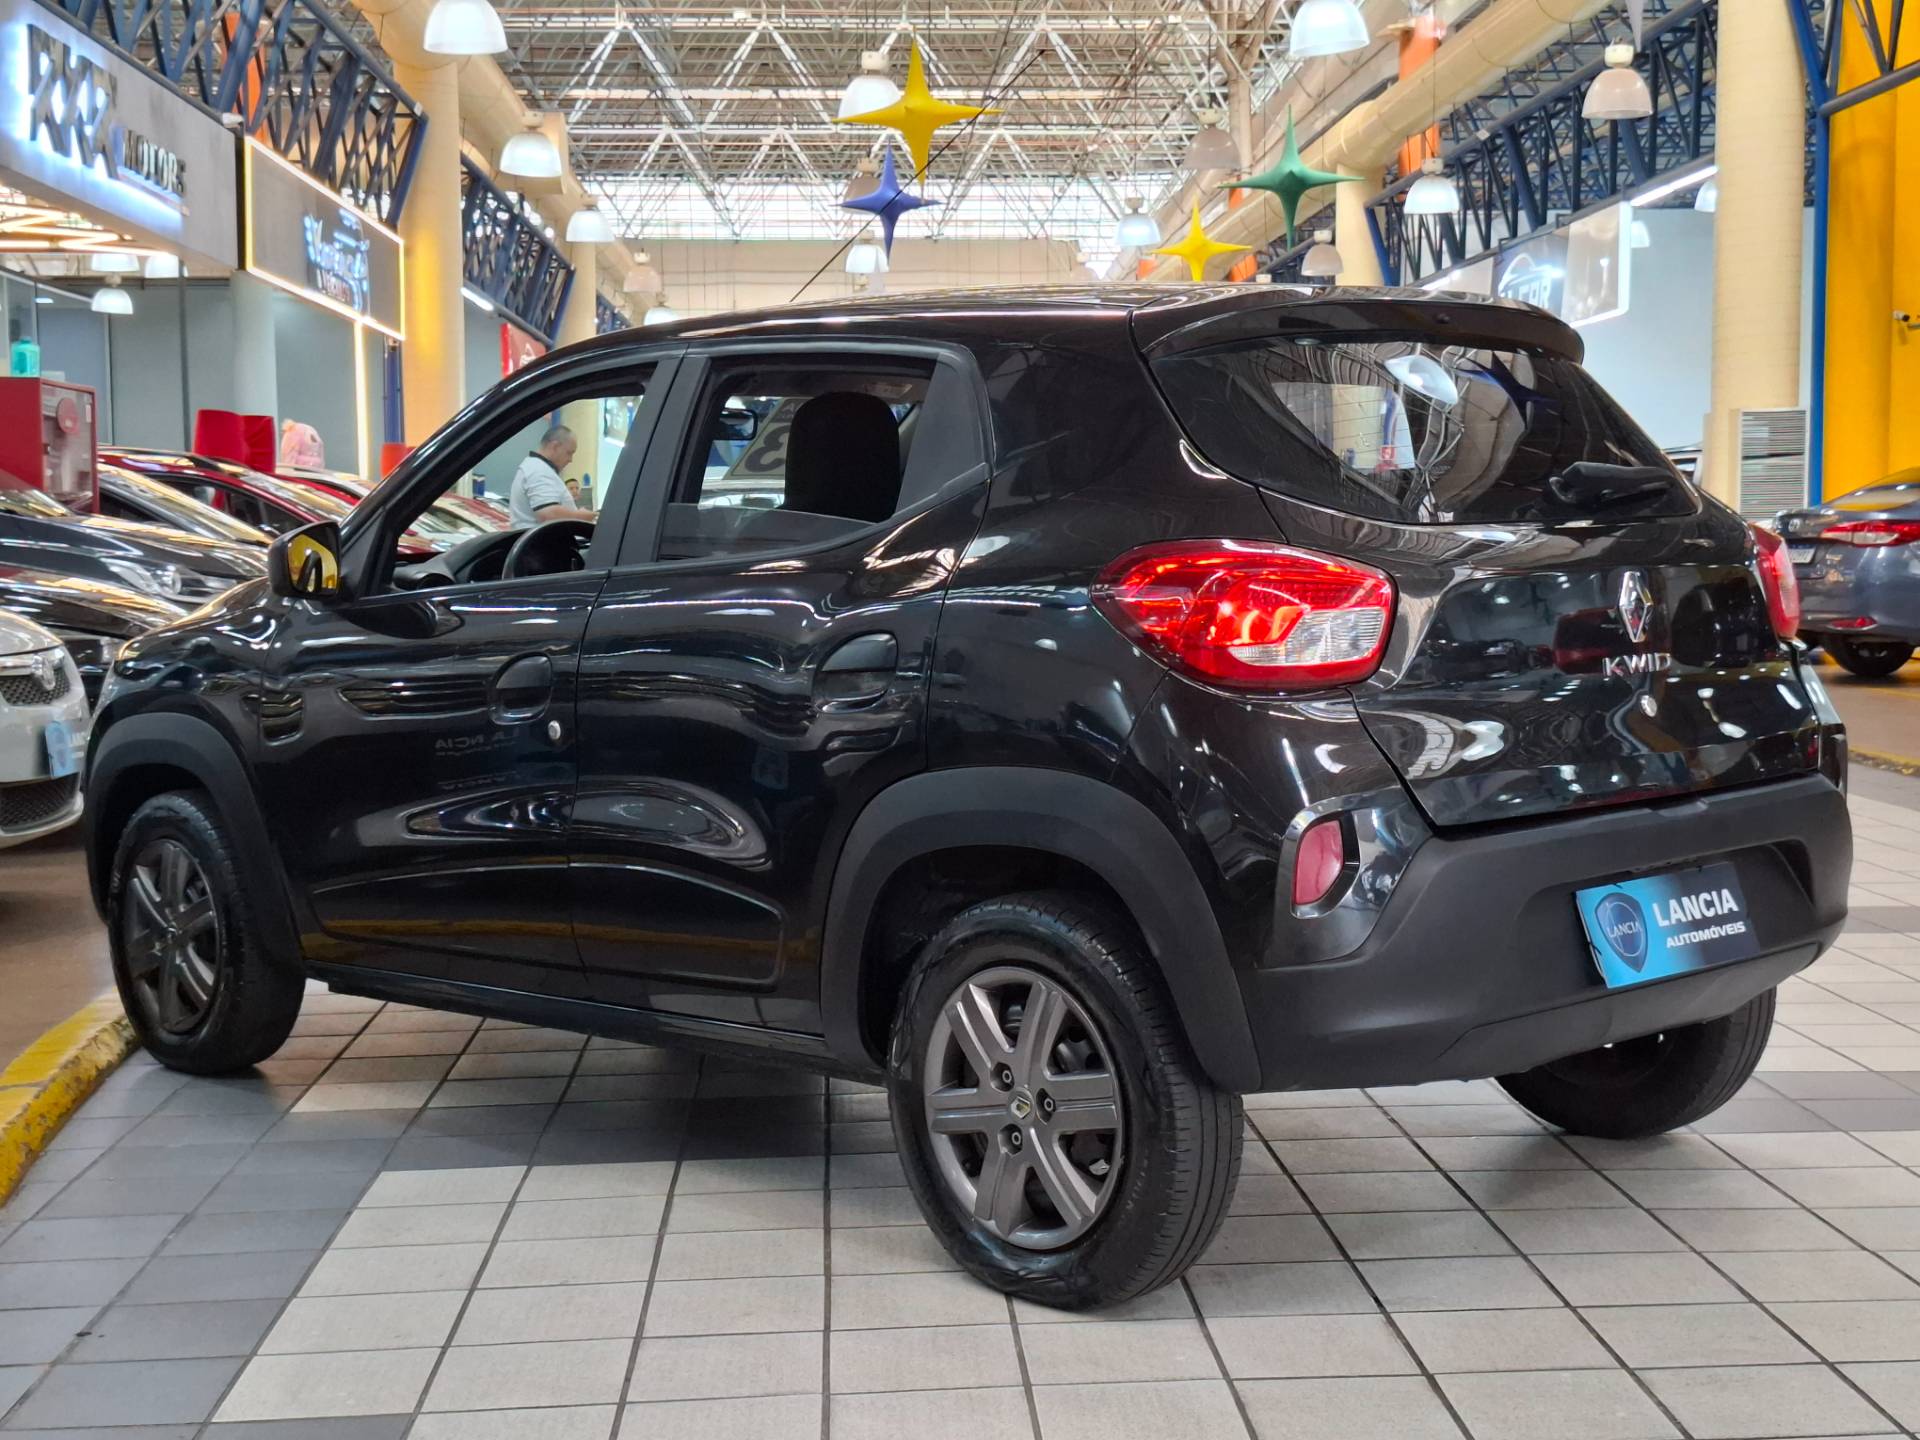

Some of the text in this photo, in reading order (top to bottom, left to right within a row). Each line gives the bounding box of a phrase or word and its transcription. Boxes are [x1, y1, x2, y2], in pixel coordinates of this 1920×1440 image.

[123, 129, 187, 196] MOTORS
[1602, 652, 1671, 677] KWID
[1652, 888, 1740, 928] LANCIA
[1606, 920, 1643, 938] LANCIA
[1666, 921, 1746, 949] AUTOMÓVEIS
